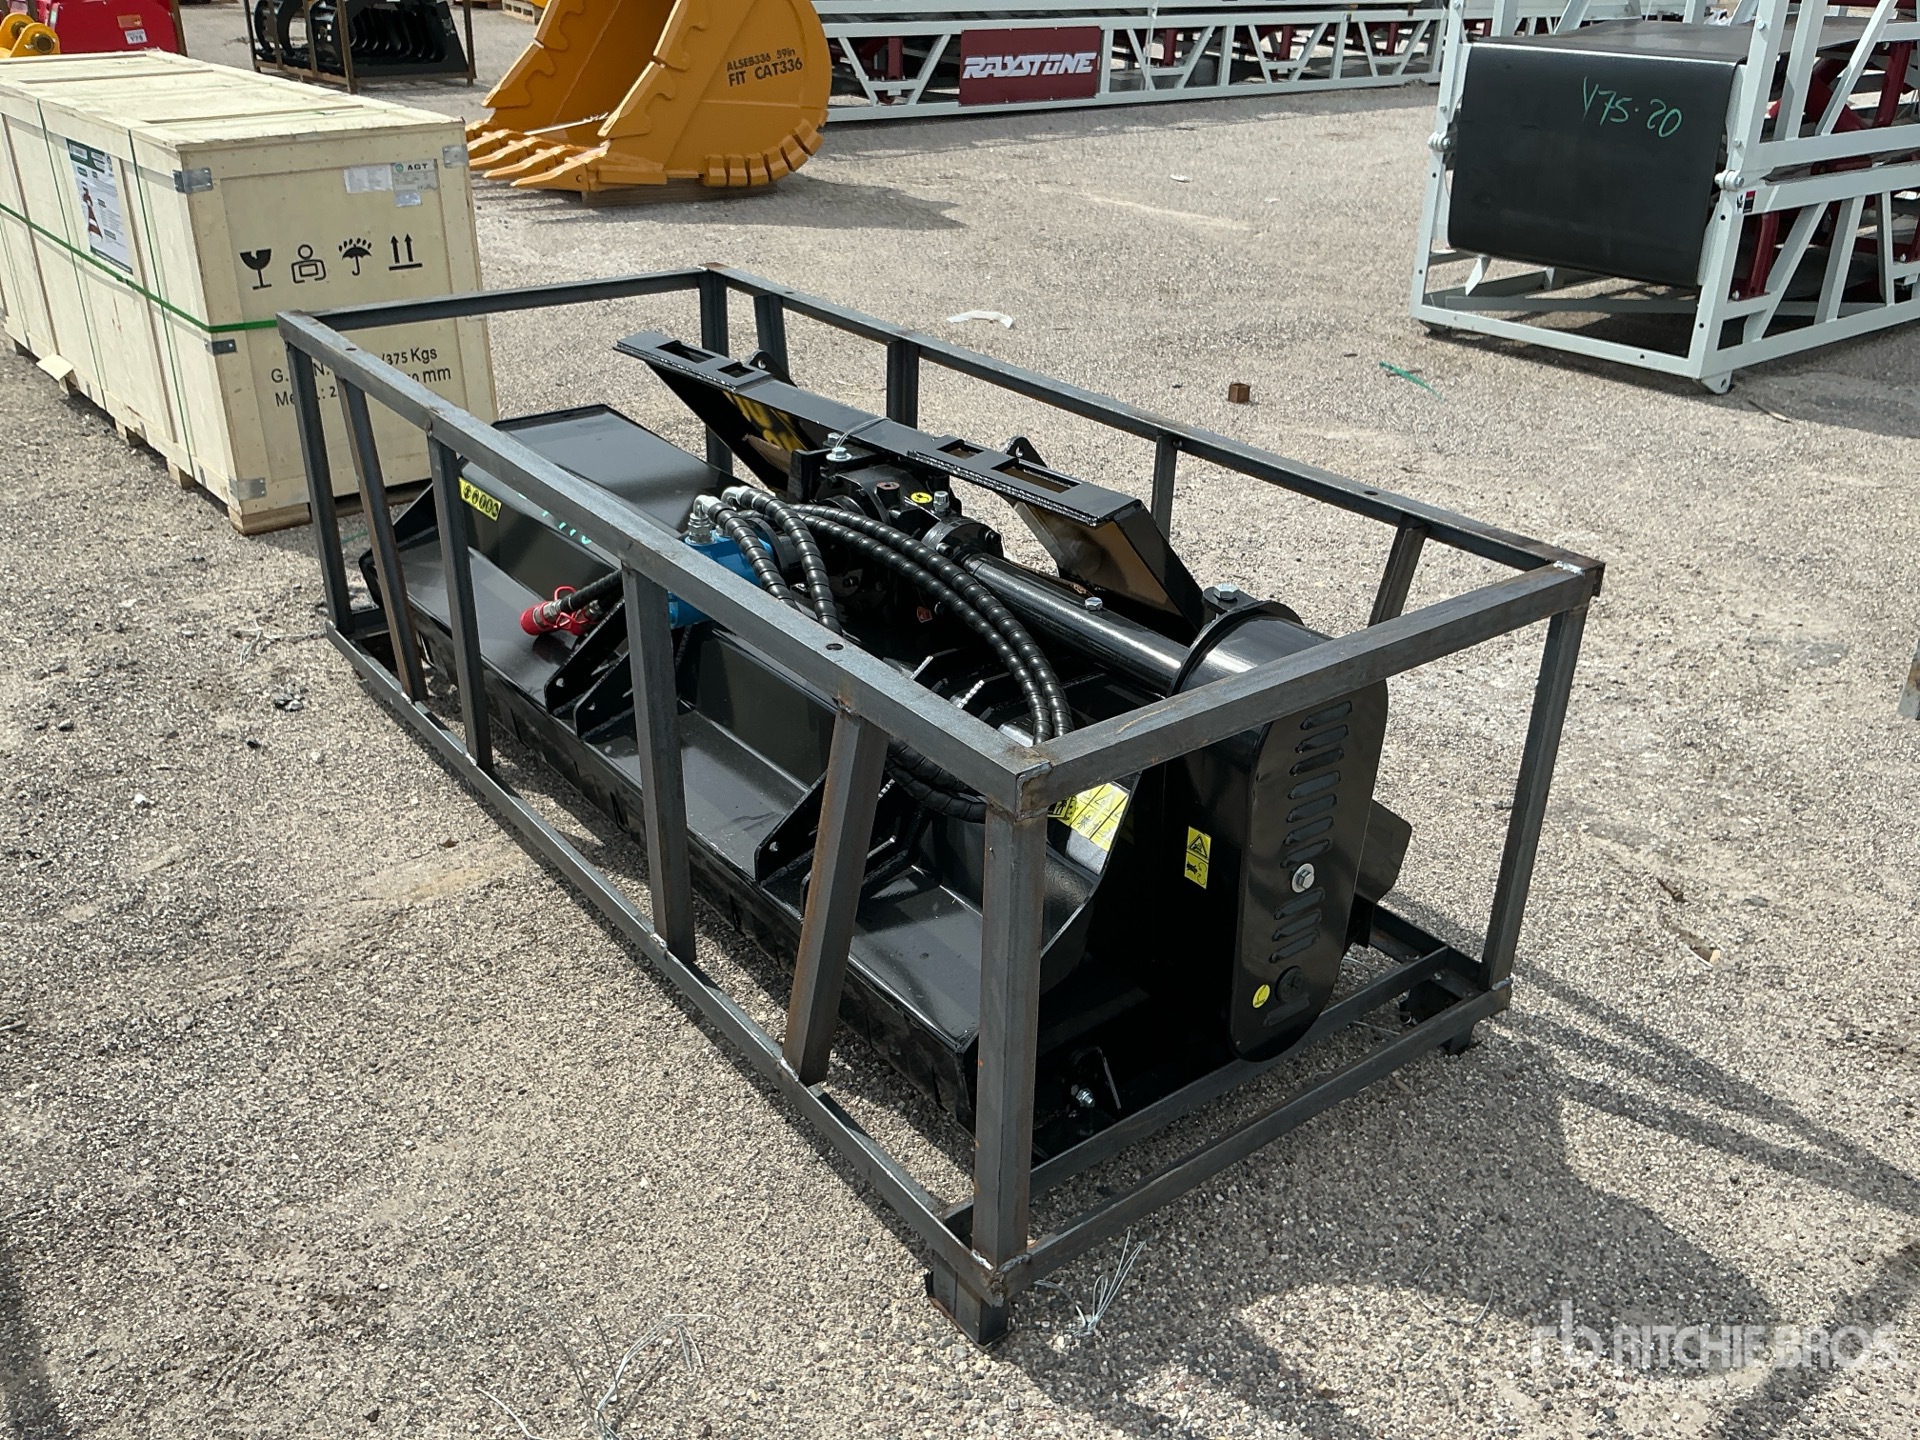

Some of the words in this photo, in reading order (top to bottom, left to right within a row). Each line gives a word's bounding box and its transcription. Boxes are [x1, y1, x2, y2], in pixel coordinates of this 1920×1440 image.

[728, 71, 746, 87] FIT
[754, 58, 803, 80] CAT336
[962, 52, 1098, 79] RAYSTONE
[410, 347, 438, 364] Kgs
[423, 368, 451, 383] mm
